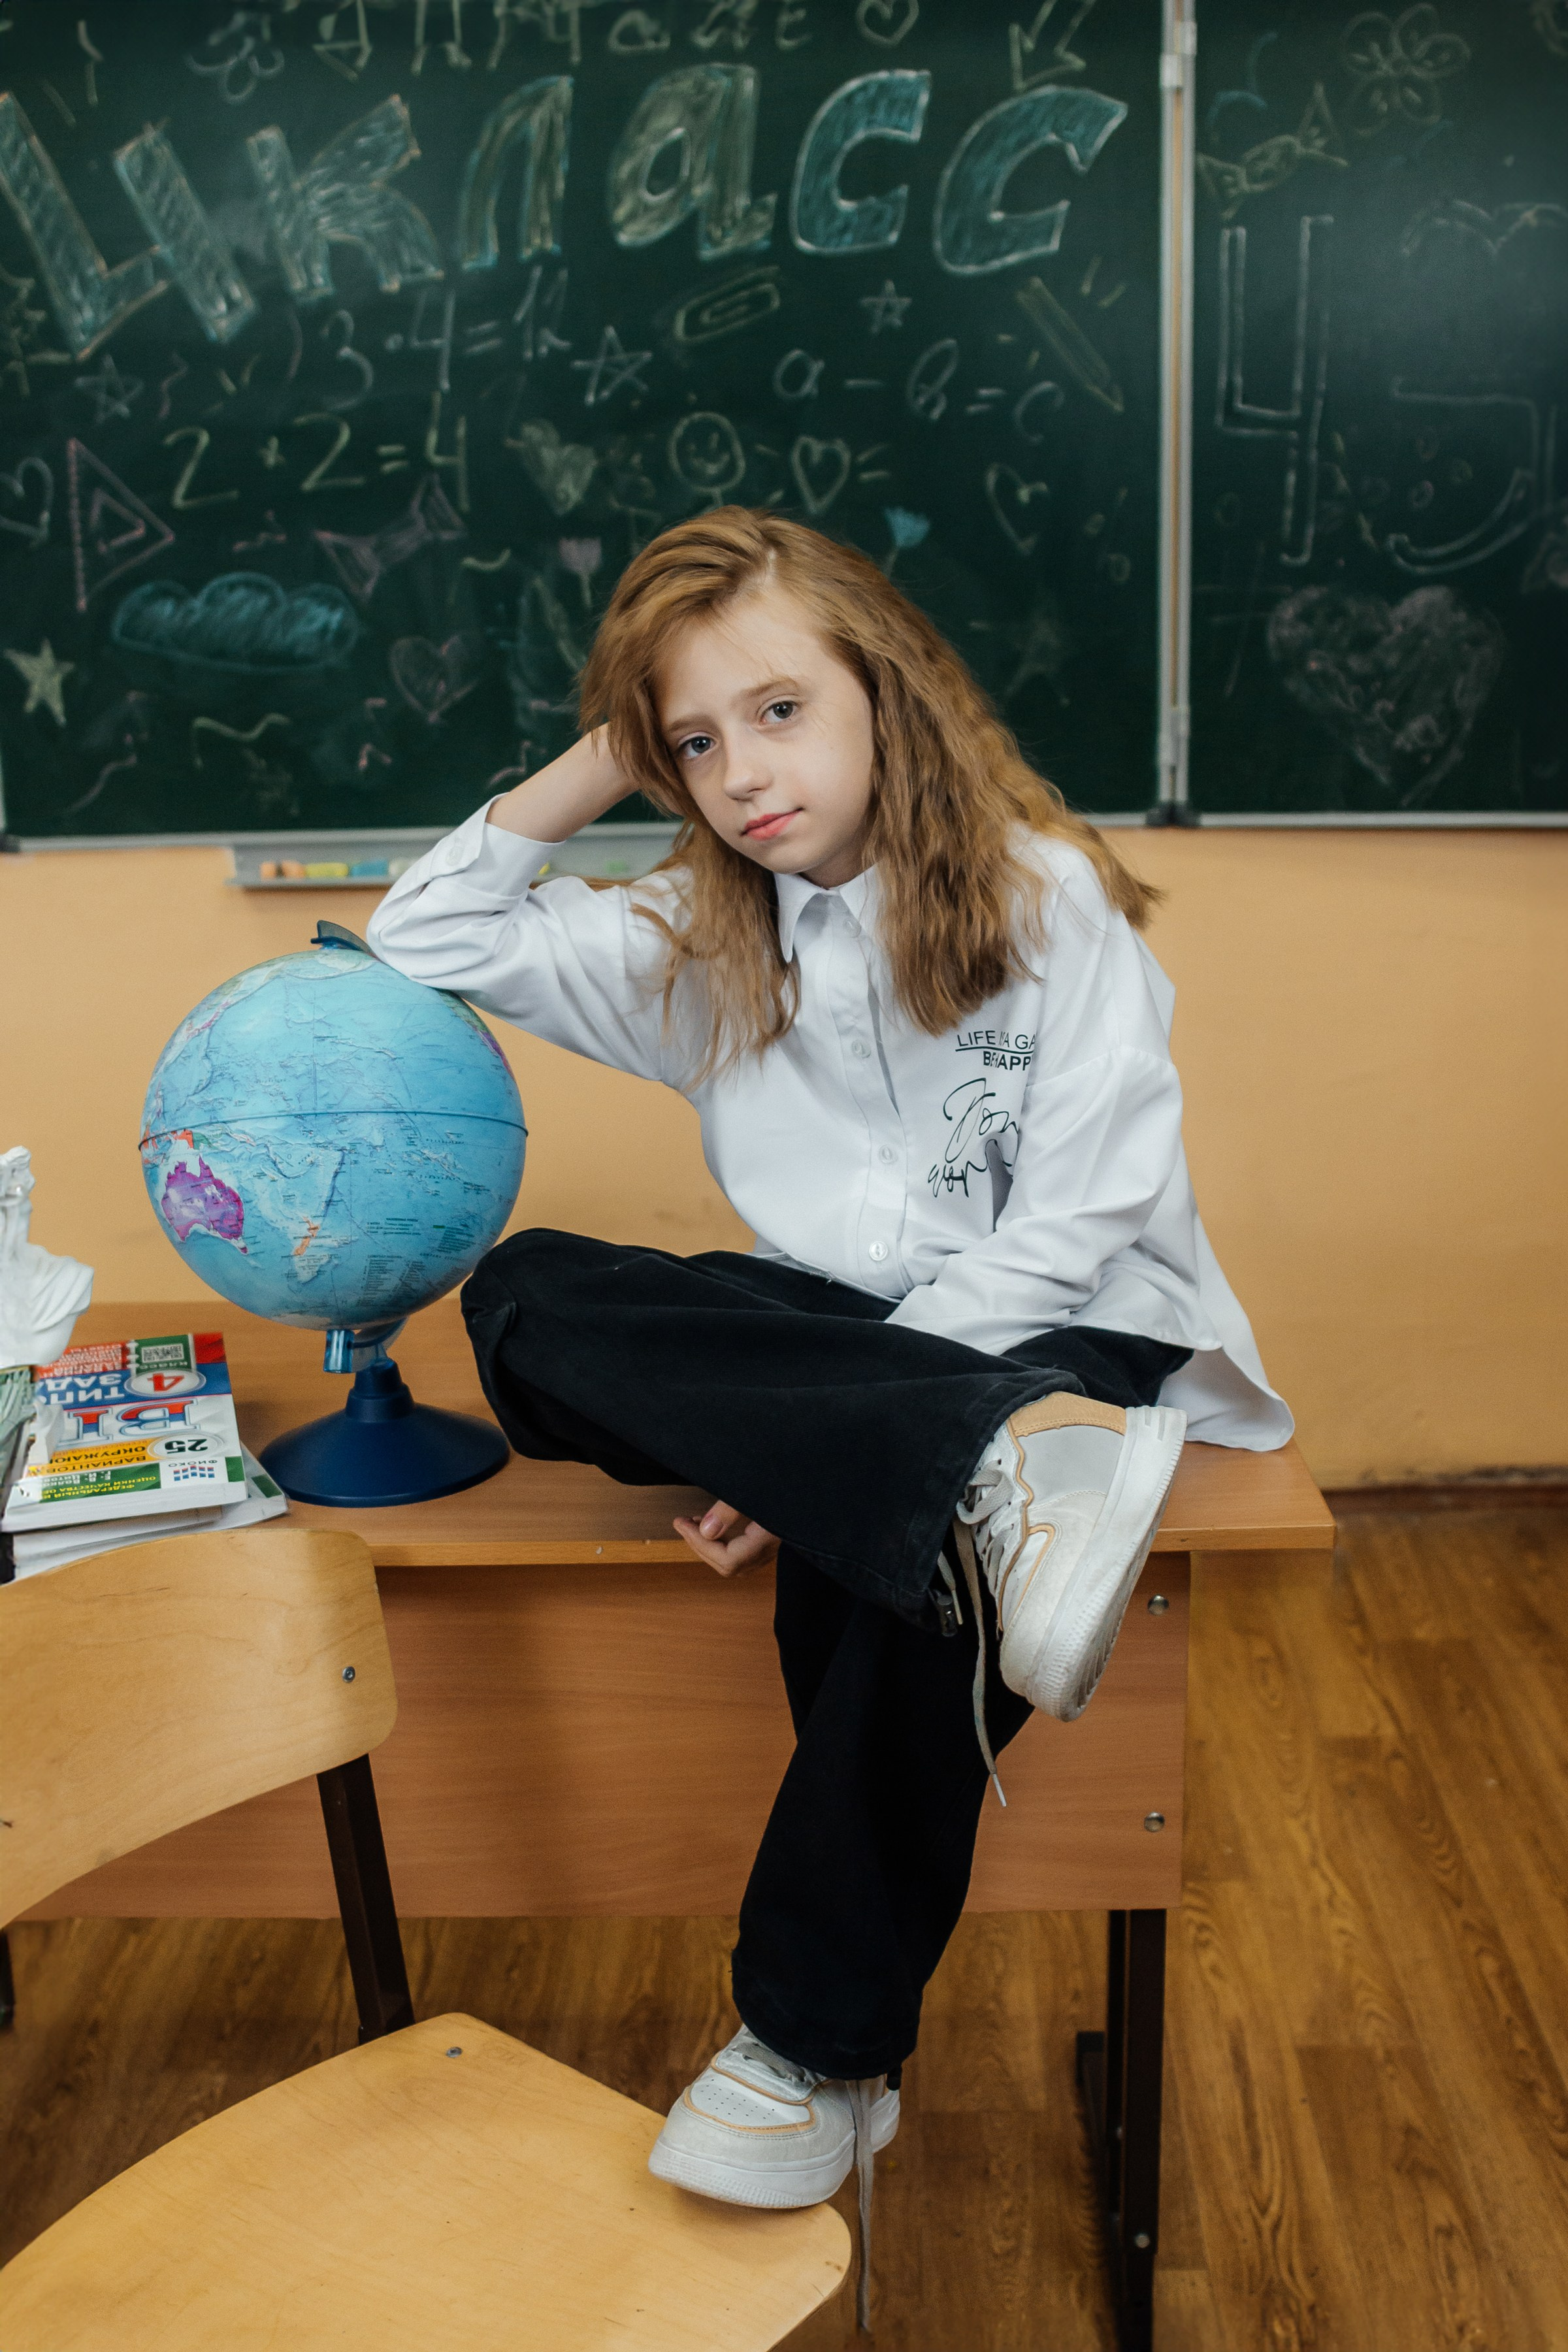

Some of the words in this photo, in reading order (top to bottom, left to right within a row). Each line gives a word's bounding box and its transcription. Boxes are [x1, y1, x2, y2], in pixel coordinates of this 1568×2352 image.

[957, 1030, 996, 1047] LIFE
[147, 1373, 184, 1392] 4
[165, 1439, 208, 1454] 25
[47, 1456, 146, 1473] ВАРИАНТОВ
[59, 1482, 110, 1492] КАЧЕСТВА
[113, 1477, 155, 1485] ОЦЕНКИ
